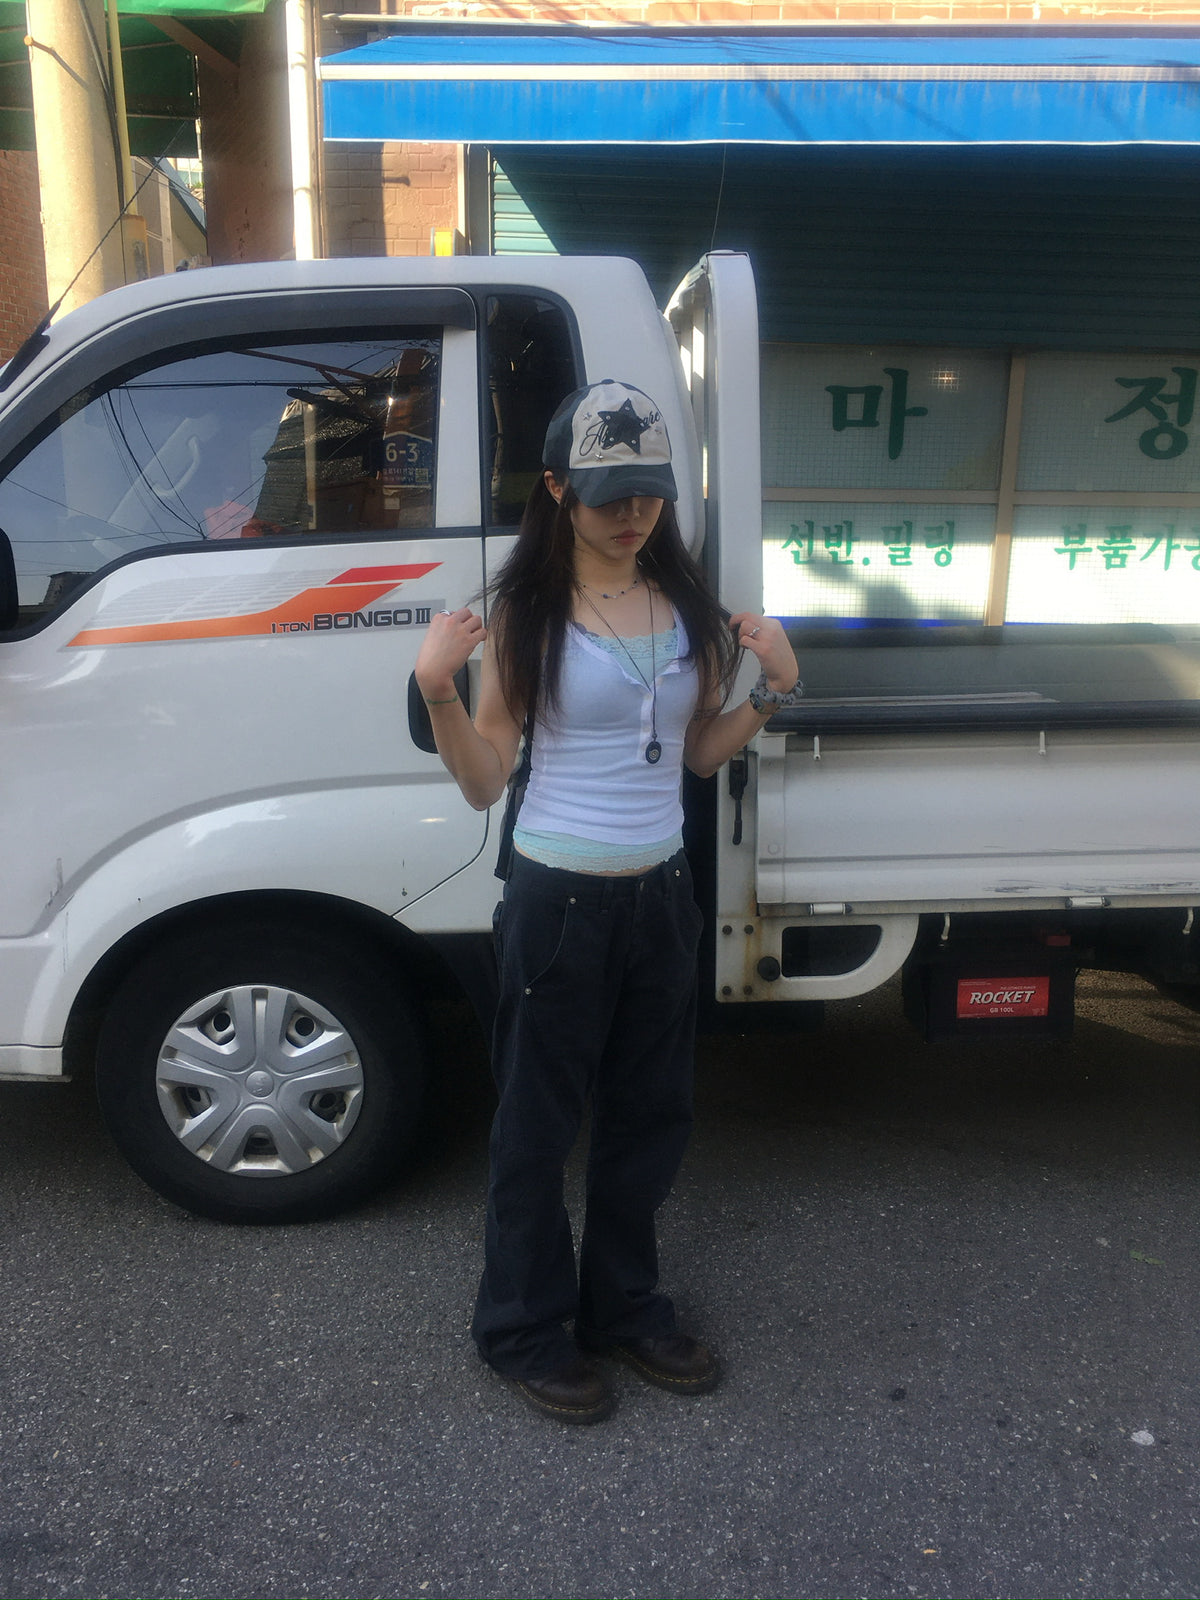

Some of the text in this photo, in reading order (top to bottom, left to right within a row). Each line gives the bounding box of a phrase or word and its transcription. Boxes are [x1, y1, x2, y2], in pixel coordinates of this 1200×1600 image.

[824, 366, 1199, 461] 마 정
[386, 443, 419, 462] 6-3
[279, 623, 310, 633] TON
[314, 609, 412, 630] BONGO
[969, 991, 1035, 1004] ROCKET
